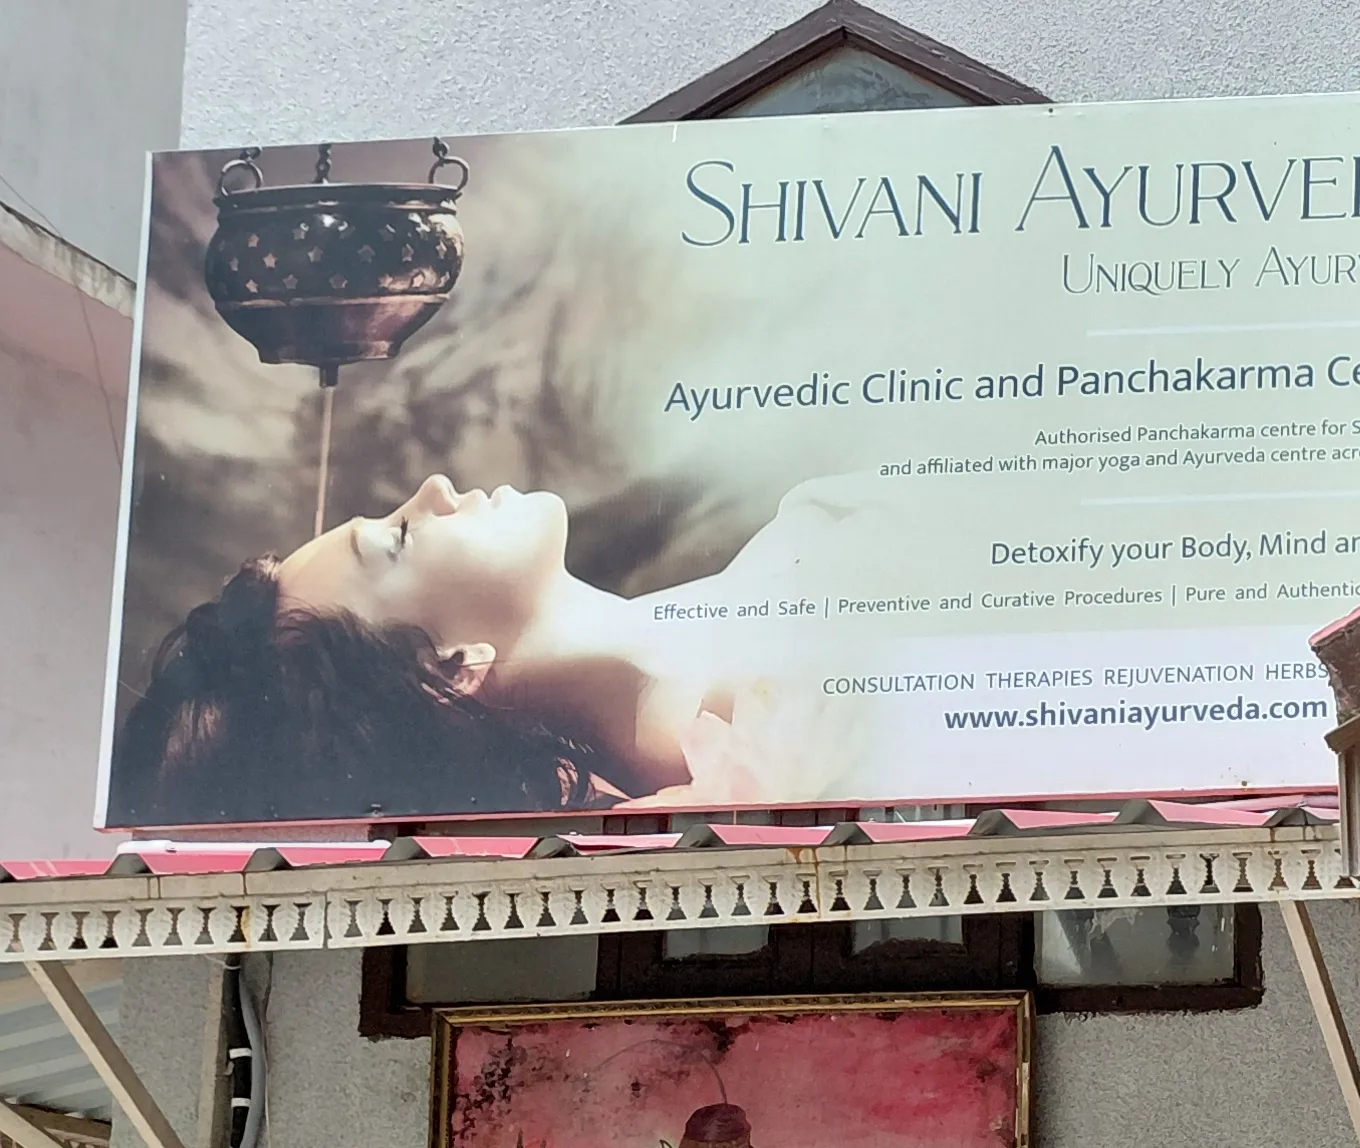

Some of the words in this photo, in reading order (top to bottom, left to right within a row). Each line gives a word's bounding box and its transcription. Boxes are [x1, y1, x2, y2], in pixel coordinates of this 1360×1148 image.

[682, 161, 982, 247] SHIVANI
[1062, 253, 1240, 296] UNIQUELY
[663, 372, 850, 422] Ayurvedic
[862, 368, 964, 404] Clinic
[974, 363, 1044, 399] and
[1057, 357, 1314, 396] Panchakarma
[1034, 425, 1132, 446] Authorised
[1137, 423, 1255, 442] Panchakarma
[1260, 421, 1317, 438] centre
[1321, 419, 1347, 436] for
[879, 459, 912, 476] and
[916, 455, 994, 475] affiliated
[998, 454, 1037, 472] with
[1042, 452, 1095, 474] major
[1097, 455, 1141, 473] yoga
[1145, 448, 1178, 466] and
[1182, 446, 1265, 469] Ayurveda
[1270, 446, 1327, 462] centre
[991, 537, 1104, 569] Detoxify
[1110, 541, 1174, 568] your
[1181, 532, 1252, 565] Body,
[1259, 529, 1326, 556] Mind
[653, 603, 729, 621] Effective
[736, 599, 769, 617] and
[778, 598, 816, 616] Safe
[838, 596, 931, 614] Preventive
[939, 592, 972, 610] and
[981, 590, 1055, 609] Curative
[1064, 587, 1163, 606] Procedures
[1186, 586, 1226, 602] Pure
[1235, 582, 1268, 600] and
[822, 673, 975, 695] CONSULTATION
[985, 669, 1093, 689] THERAPIES
[1104, 664, 1254, 688] REJUVENATION
[1265, 662, 1329, 681] HERBS
[944, 695, 1328, 731] www.shivaniayurveda.com
